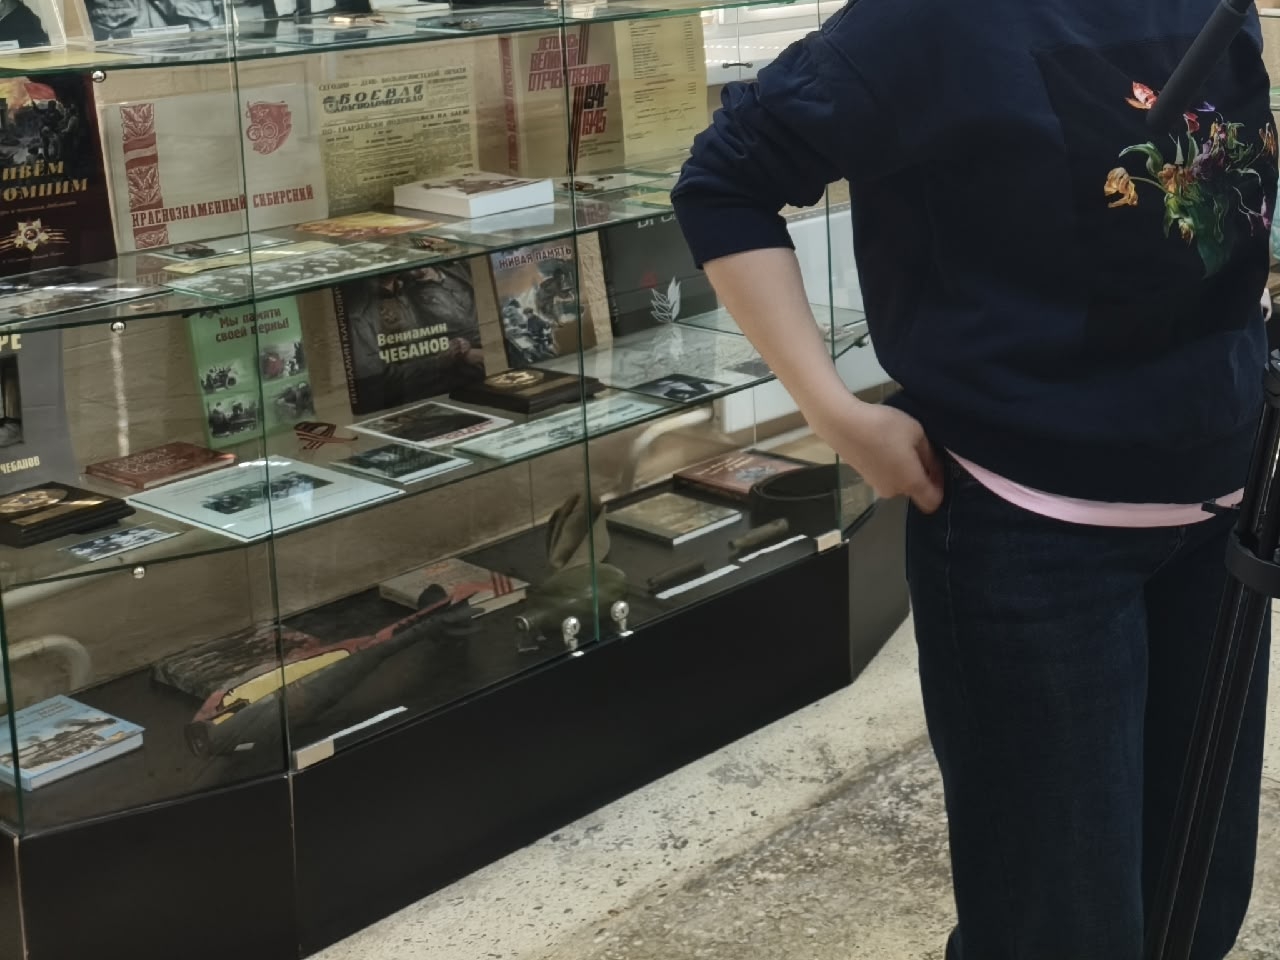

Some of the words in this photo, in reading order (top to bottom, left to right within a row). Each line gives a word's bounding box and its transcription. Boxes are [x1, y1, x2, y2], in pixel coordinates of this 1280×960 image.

[528, 64, 611, 91] ОТЕЧЕТВЕННОЙ
[338, 84, 423, 105] БОЕВАЯ
[2, 160, 64, 181] ИВЁМ
[3, 178, 88, 202] ОМНИМ
[132, 193, 247, 227] КРАСНОЗНАМЕННЫЙ
[253, 184, 314, 208] СИБИРСКИЙ
[499, 253, 534, 269] ЖИВАЯ
[535, 245, 572, 261] ПАМЯТЬ
[219, 316, 239, 329] Мы
[377, 322, 448, 347] Вениамин
[216, 327, 247, 343] своей
[379, 336, 449, 364] ЧЕБАНОВ
[0, 456, 40, 474] ЧЕБАНОВ
